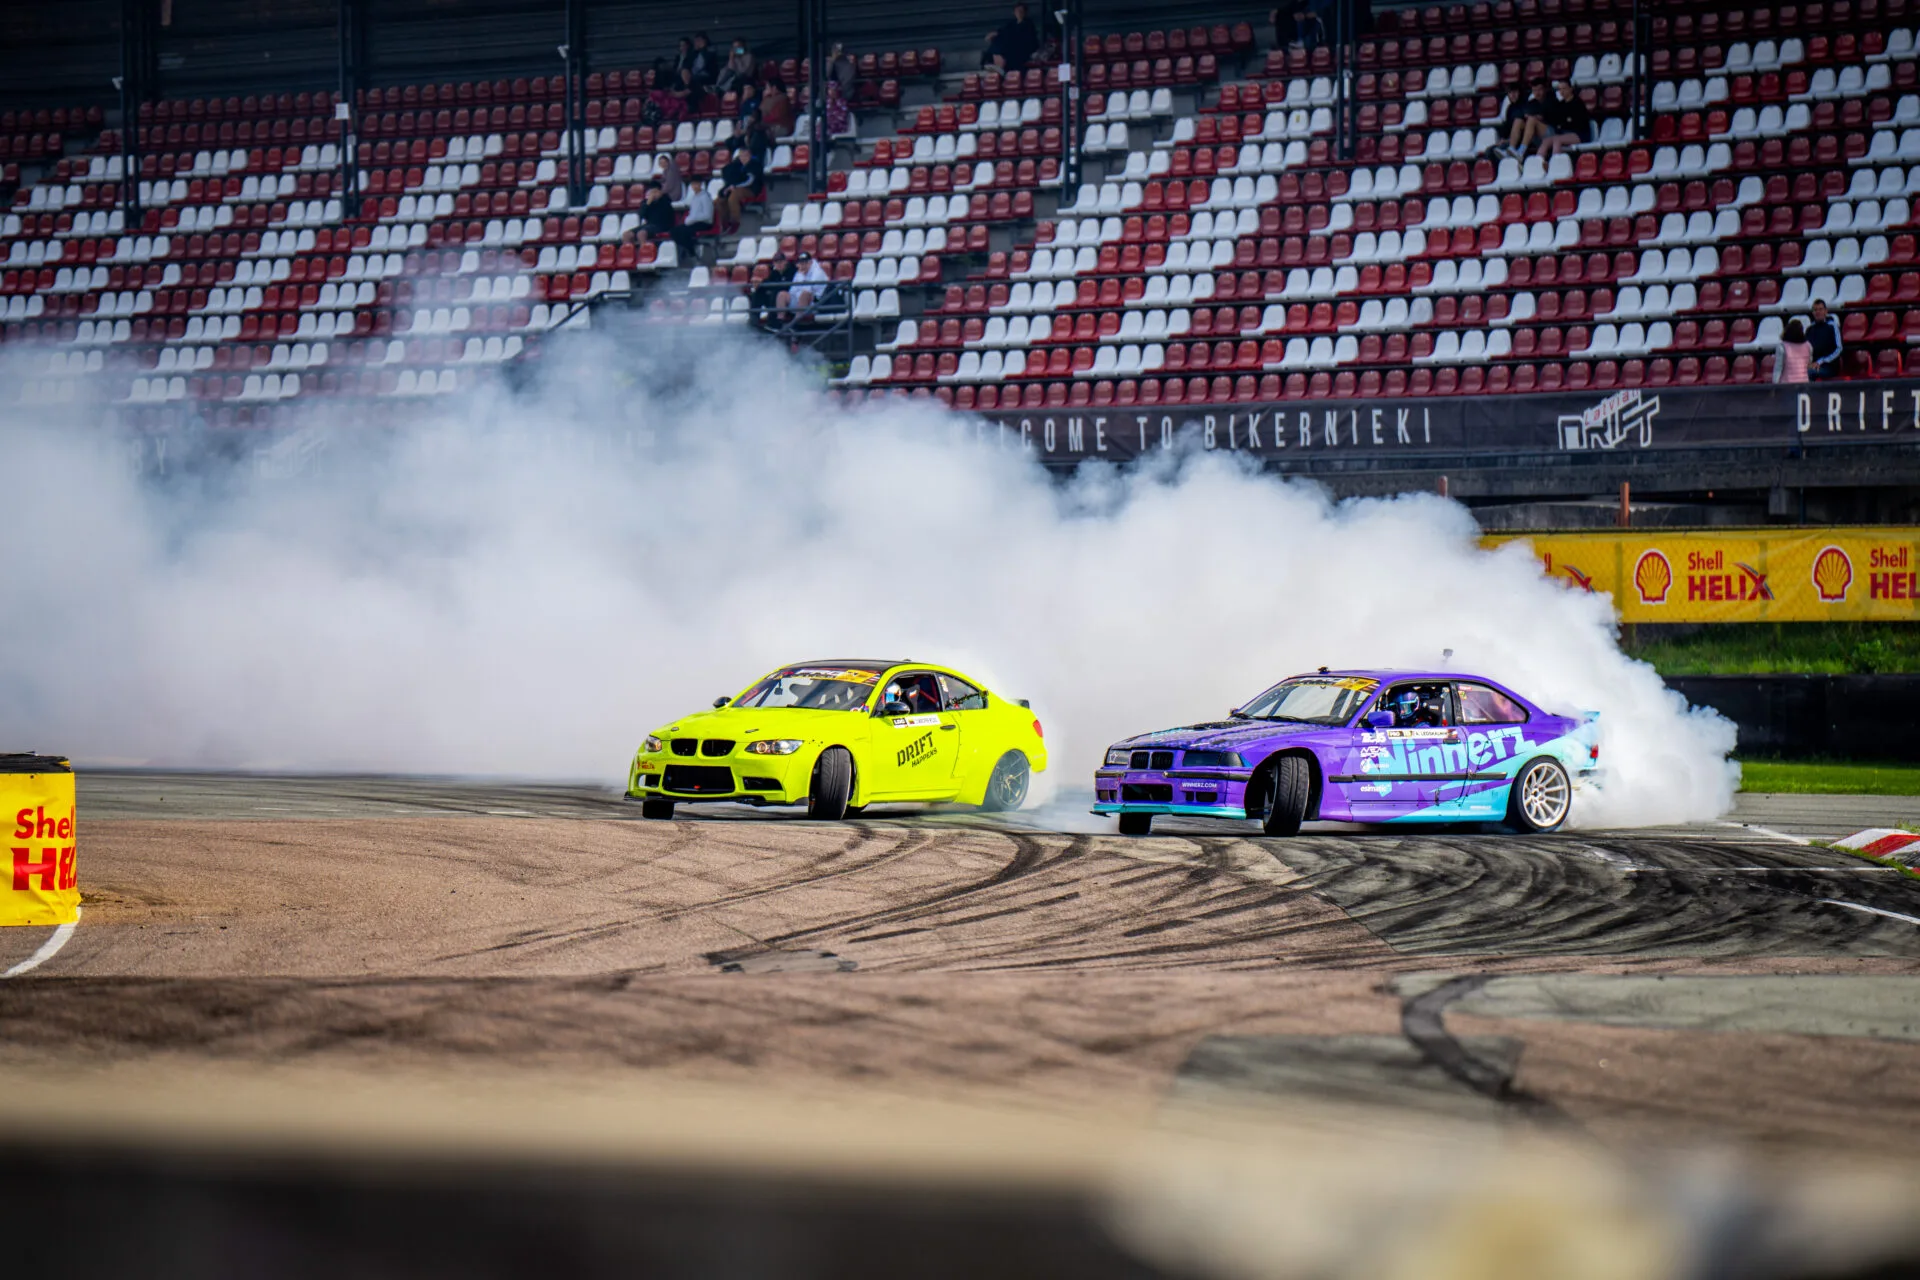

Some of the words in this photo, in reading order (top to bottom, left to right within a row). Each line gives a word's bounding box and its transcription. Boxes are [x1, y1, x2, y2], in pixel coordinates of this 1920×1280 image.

[1558, 394, 1659, 450] DRIFT
[1797, 389, 1920, 432] DRIFT
[1136, 416, 1173, 452] TO
[1203, 407, 1431, 450] BIKERNIEKI
[1687, 550, 1723, 570] Shell
[1870, 546, 1907, 568] Shell
[1687, 572, 1773, 601] HELIX
[1869, 572, 1920, 599] HEL
[897, 731, 934, 767] DRIFT
[911, 746, 938, 768] HAPPENS
[1366, 726, 1539, 797] Winnerz
